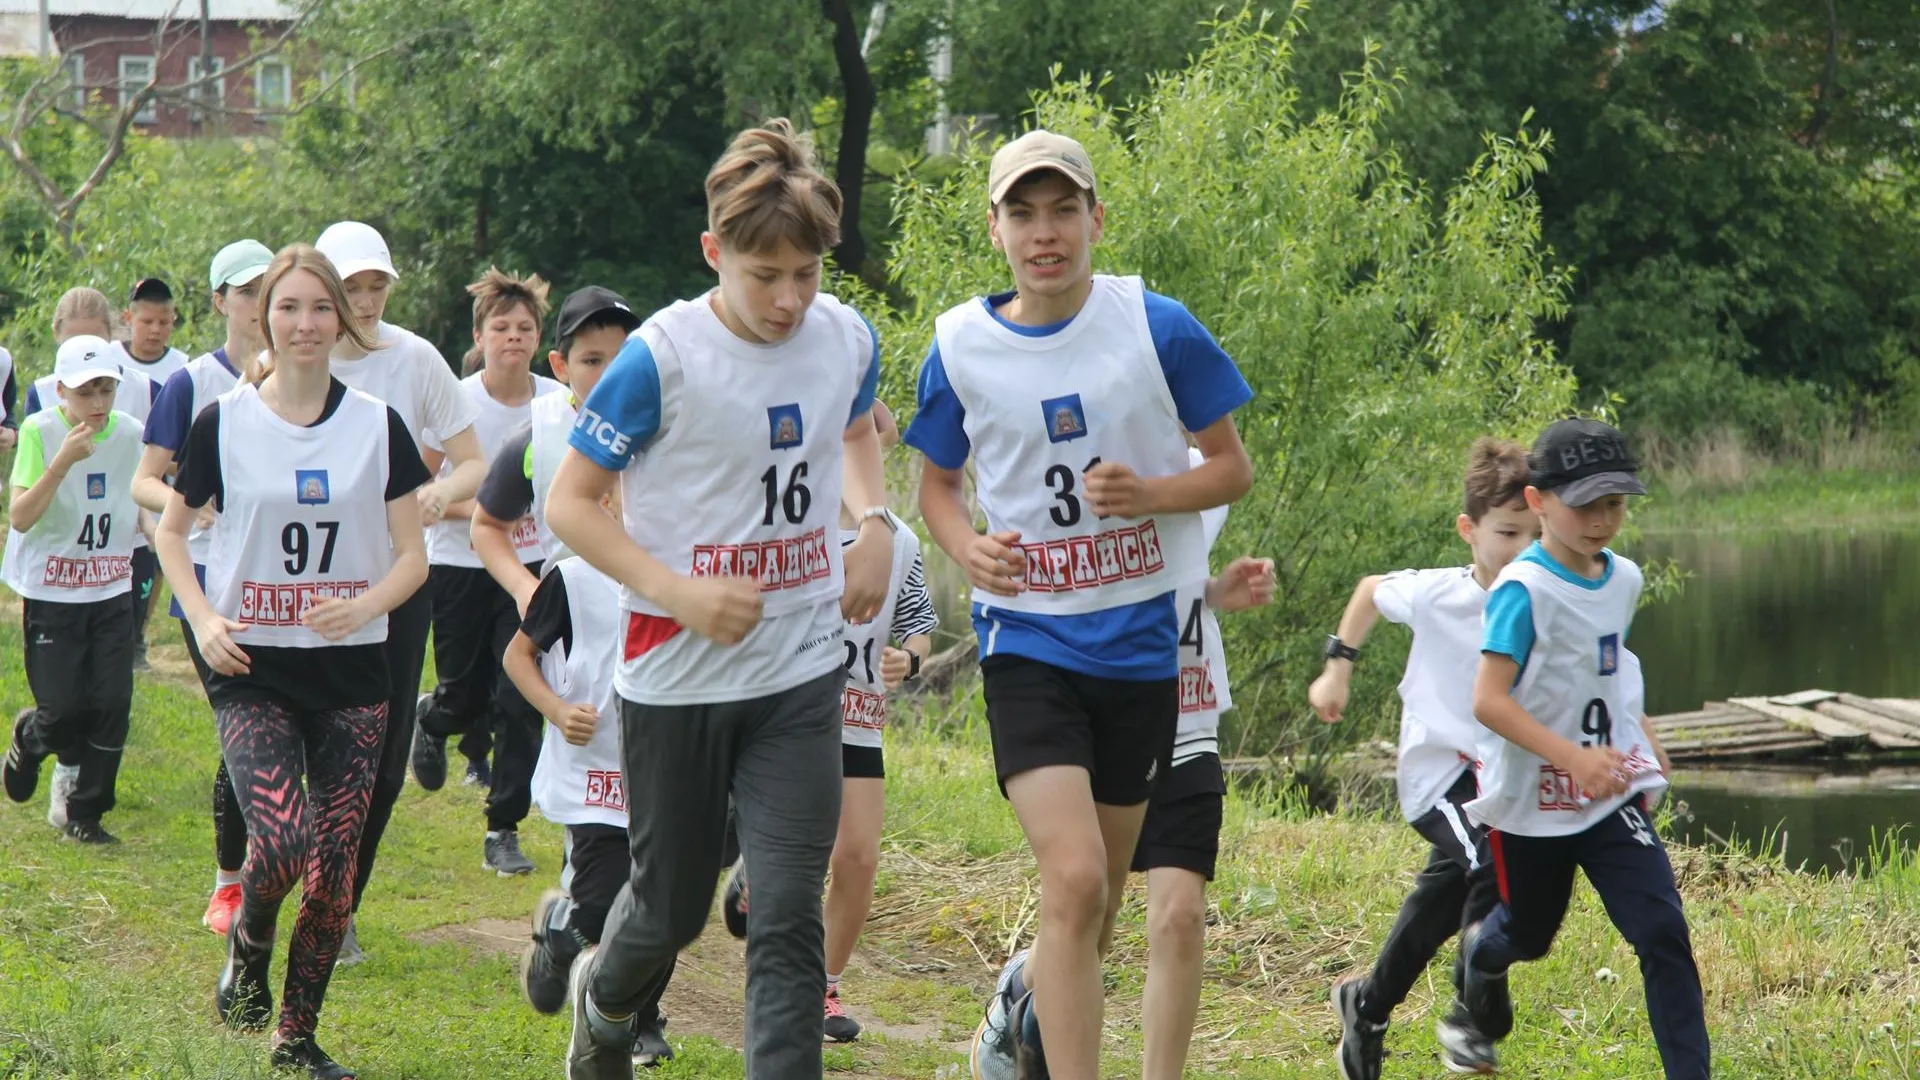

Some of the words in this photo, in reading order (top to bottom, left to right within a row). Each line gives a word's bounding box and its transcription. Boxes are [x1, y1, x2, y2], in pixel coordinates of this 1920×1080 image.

[575, 407, 632, 455] ПСБ
[760, 460, 811, 526] 16
[1045, 456, 1111, 527] 3
[77, 513, 111, 551] 49
[281, 521, 340, 576] 97
[692, 530, 831, 590] ЗАРАЙСК
